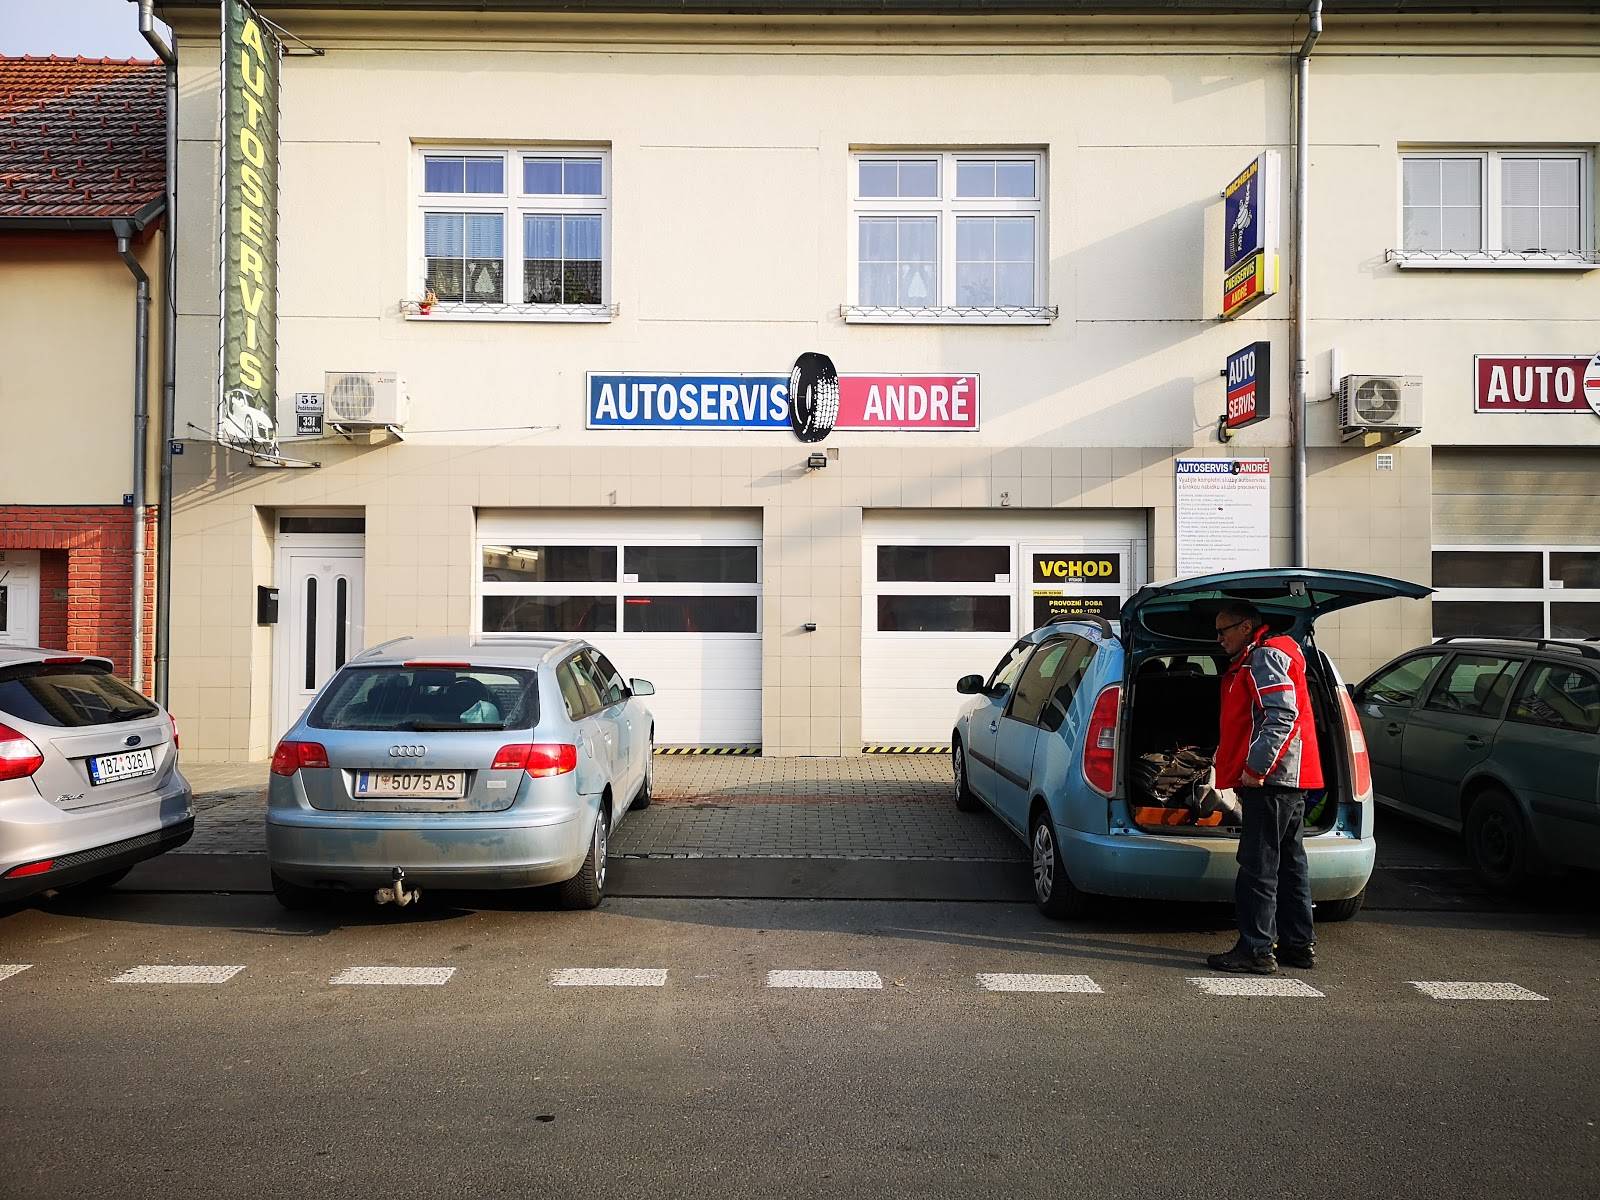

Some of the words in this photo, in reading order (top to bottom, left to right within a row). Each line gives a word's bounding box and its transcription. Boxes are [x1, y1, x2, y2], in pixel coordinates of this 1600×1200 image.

[1226, 162, 1258, 198] MICHELIN
[239, 18, 265, 390] AUTOSERVIS
[1225, 261, 1254, 292] PNEUSERVIS
[1228, 351, 1256, 387] AUTO
[1487, 365, 1576, 403] AUTO
[595, 383, 789, 421] AUTOSERVIS
[863, 377, 969, 421] ANDRÉ
[1228, 390, 1256, 419] SERVIS
[303, 416, 316, 426] 331
[1177, 463, 1229, 473] AUTOSERVIS
[1240, 462, 1268, 473] ANDRÉ
[1000, 491, 1009, 507] 2
[1039, 560, 1113, 577] VCHOD
[100, 757, 120, 775] 1BZ
[125, 752, 150, 770] 3261
[391, 774, 432, 790] 5075
[434, 775, 456, 790] AS
